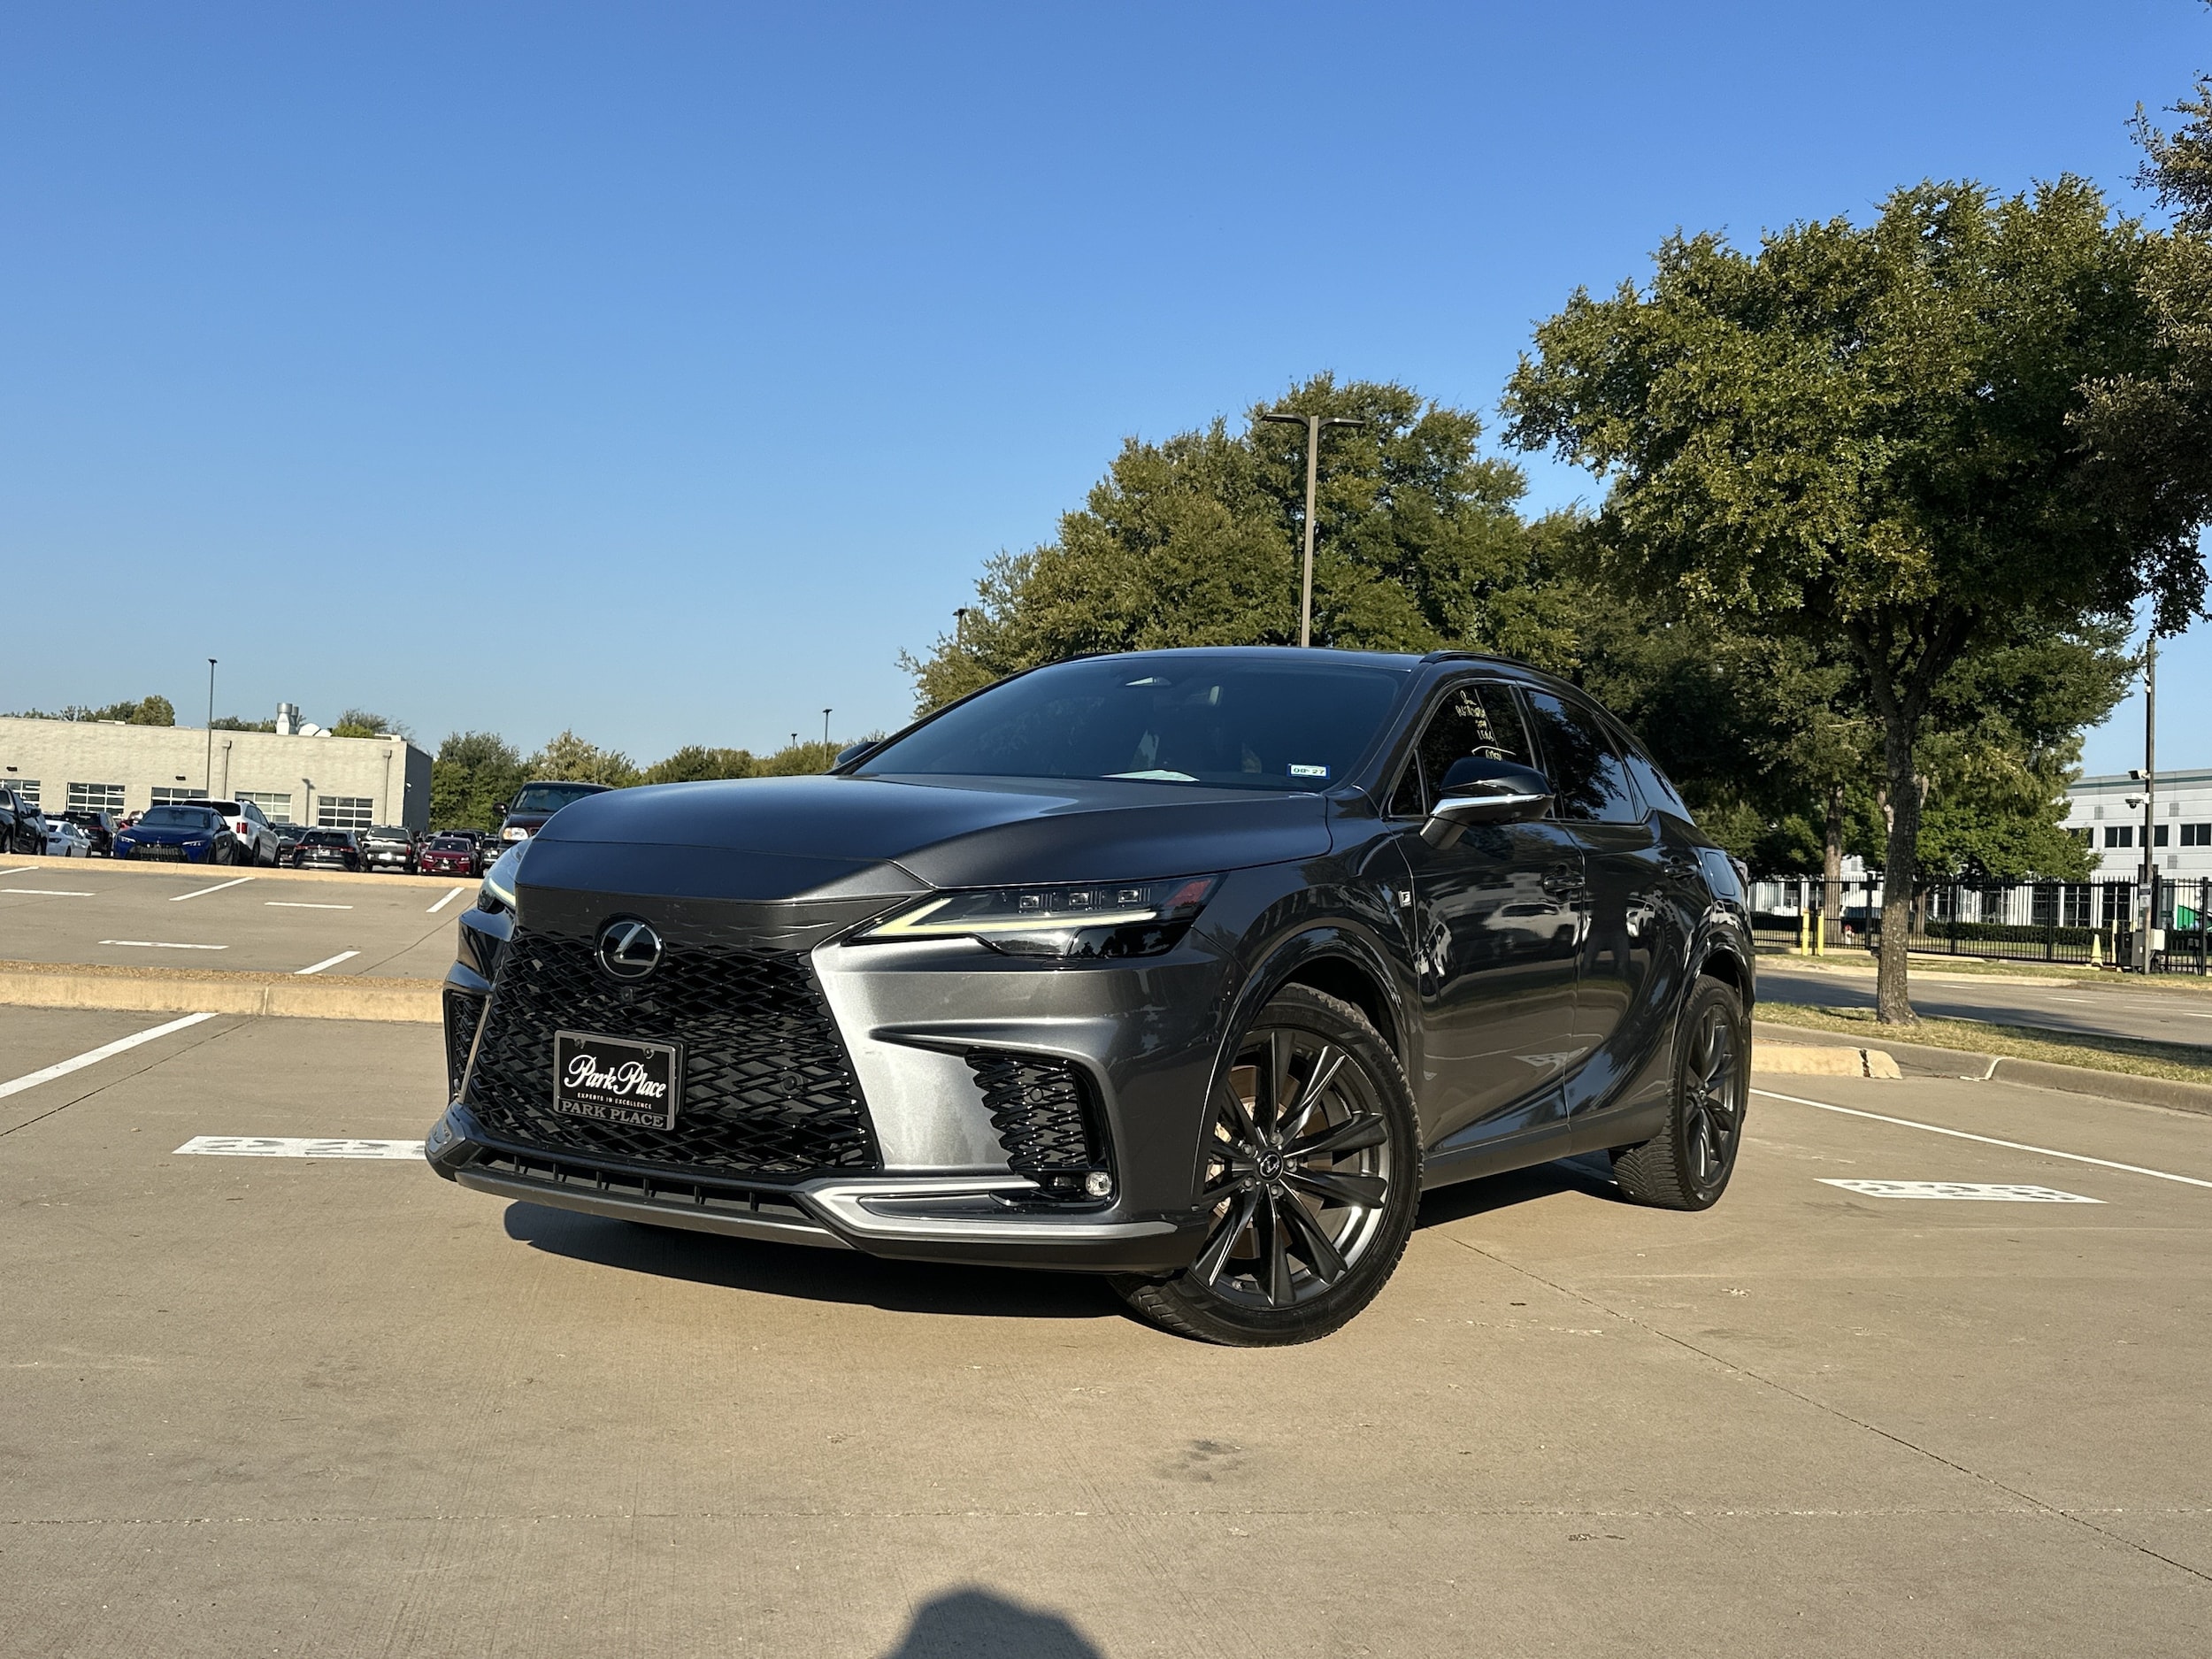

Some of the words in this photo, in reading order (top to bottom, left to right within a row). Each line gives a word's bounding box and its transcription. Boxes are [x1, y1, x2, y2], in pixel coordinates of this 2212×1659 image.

[564, 1055, 617, 1090] Park
[613, 1061, 666, 1098] Place
[562, 1101, 606, 1118] PARK
[610, 1109, 664, 1128] PLACE
[577, 1092, 603, 1102] EXPERTS
[614, 1098, 652, 1110] EXCELLENCE
